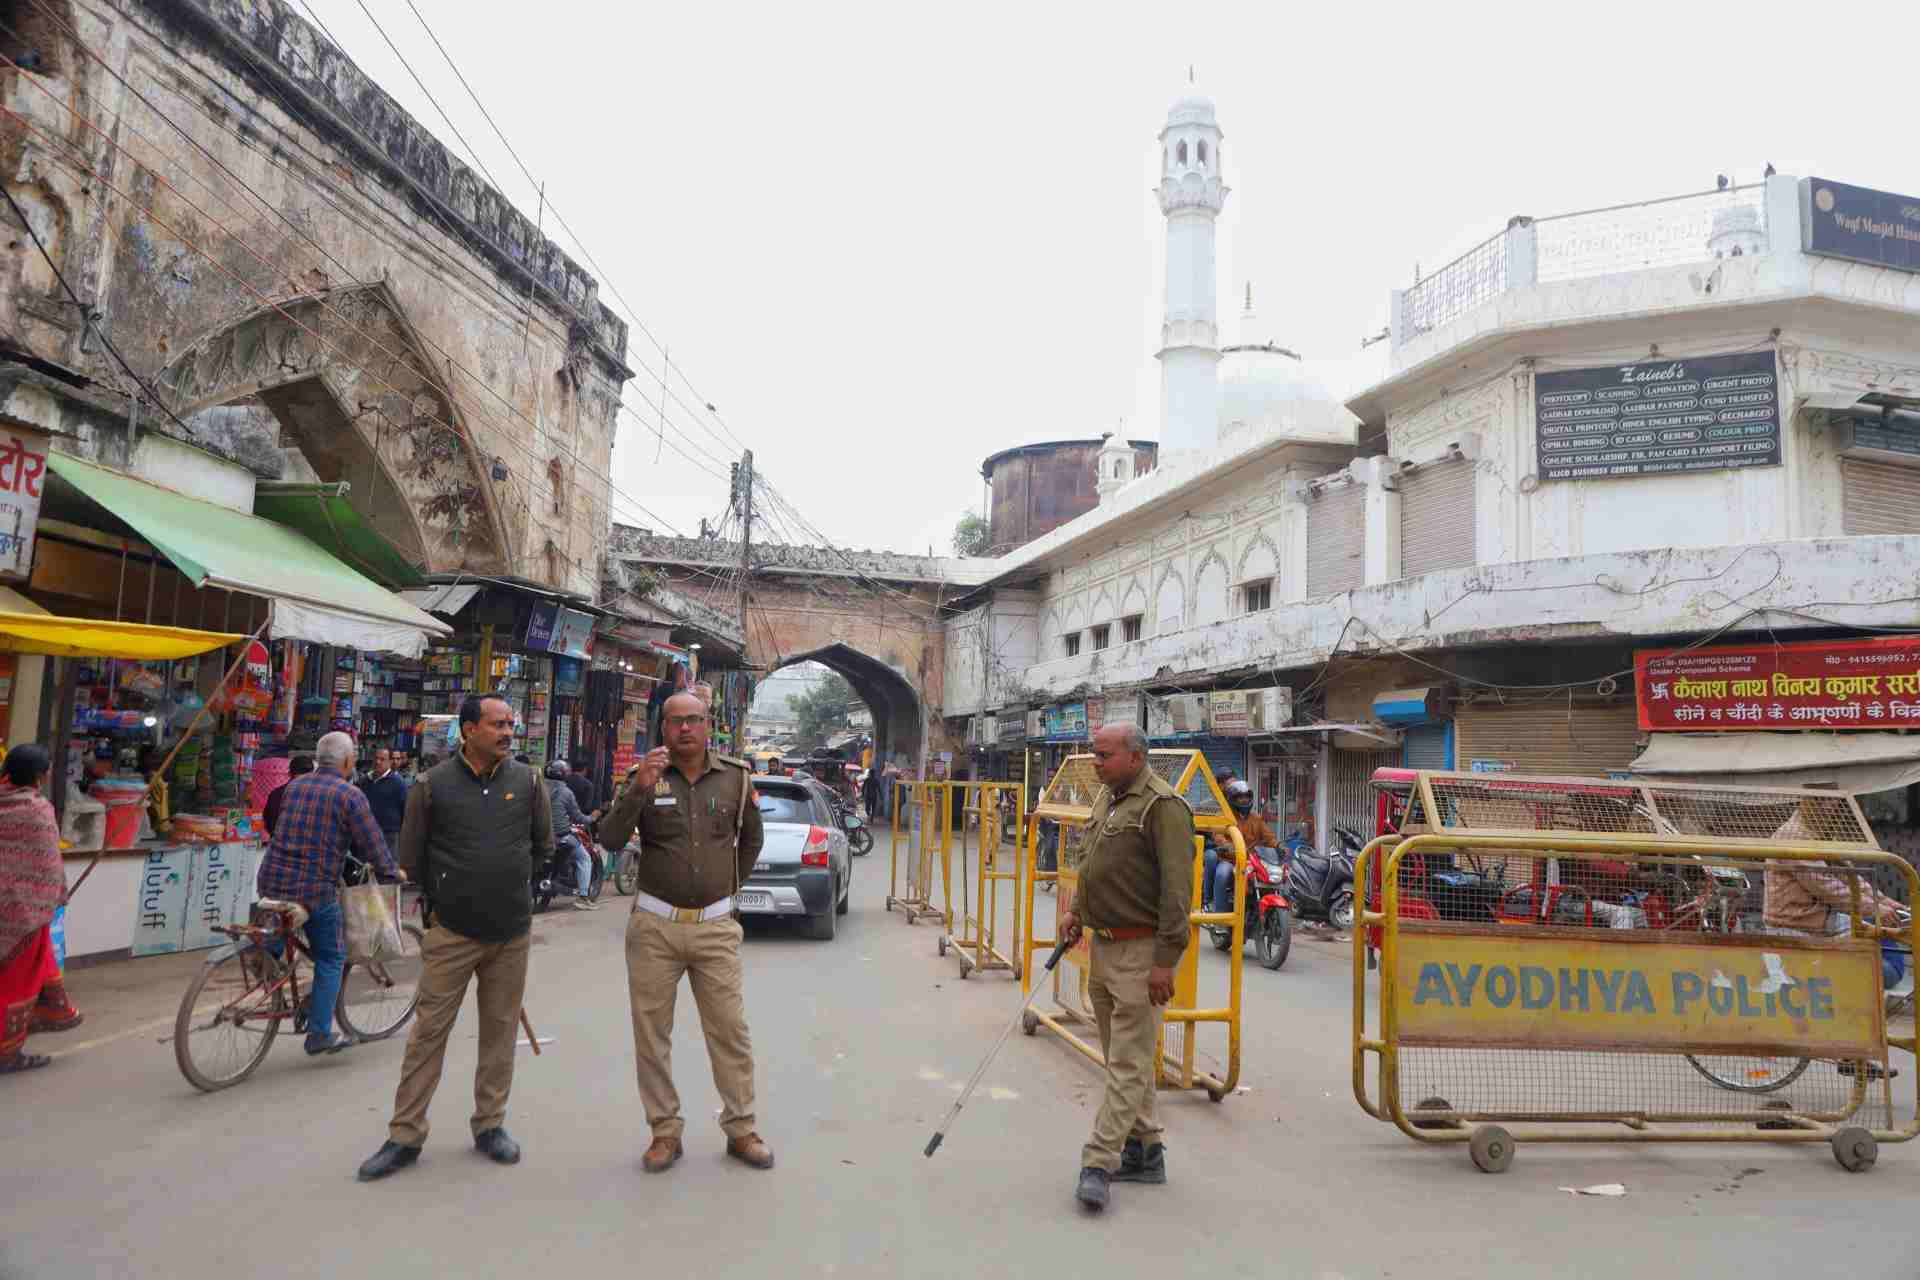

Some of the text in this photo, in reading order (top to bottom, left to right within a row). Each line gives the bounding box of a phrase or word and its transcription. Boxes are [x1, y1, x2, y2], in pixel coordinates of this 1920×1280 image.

[1620, 363, 1684, 383] Zaineb's
[1706, 377, 1770, 389] URGENT PHOTO
[1647, 384, 1697, 394] LAMINATION
[1543, 393, 1588, 403] PHOTOCOPY
[1598, 390, 1638, 400] SCANNING
[1704, 393, 1769, 405] FUND TRANSFER
[1658, 399, 1694, 409] PAYMENT
[1575, 406, 1617, 416] DOWNLOAD
[1721, 409, 1771, 419] RECHARGES
[1649, 416, 1681, 425] ENGLISH
[1685, 414, 1713, 423] TYPING
[1544, 422, 1615, 433] DIGITAL PRINTOUT
[1709, 424, 1770, 437] COLOUR PRINT
[1625, 434, 1652, 442] CARDS
[1663, 431, 1696, 440] RESUME
[1545, 438, 1606, 449] SPIRAL BINDING
[1545, 455, 1574, 465] ONLINE
[1667, 448, 1690, 457] CARD
[1700, 445, 1742, 455] PASSPORT
[1744, 442, 1771, 452] FILING
[1572, 466, 1608, 476] BUSINESS
[1611, 464, 1639, 473] CENTRE
[1719, 665, 1752, 673] Scheme
[1673, 675, 1728, 698] कैलाश
[1730, 679, 1769, 697] नाथ
[1771, 672, 1821, 697] विनय
[1825, 675, 1882, 701] कुमार
[1673, 704, 1705, 720] सोने
[1710, 708, 1722, 720] व
[1767, 703, 1784, 720] के
[1865, 701, 1885, 719] के
[1413, 961, 1834, 1019] AYODHYA POLICE
